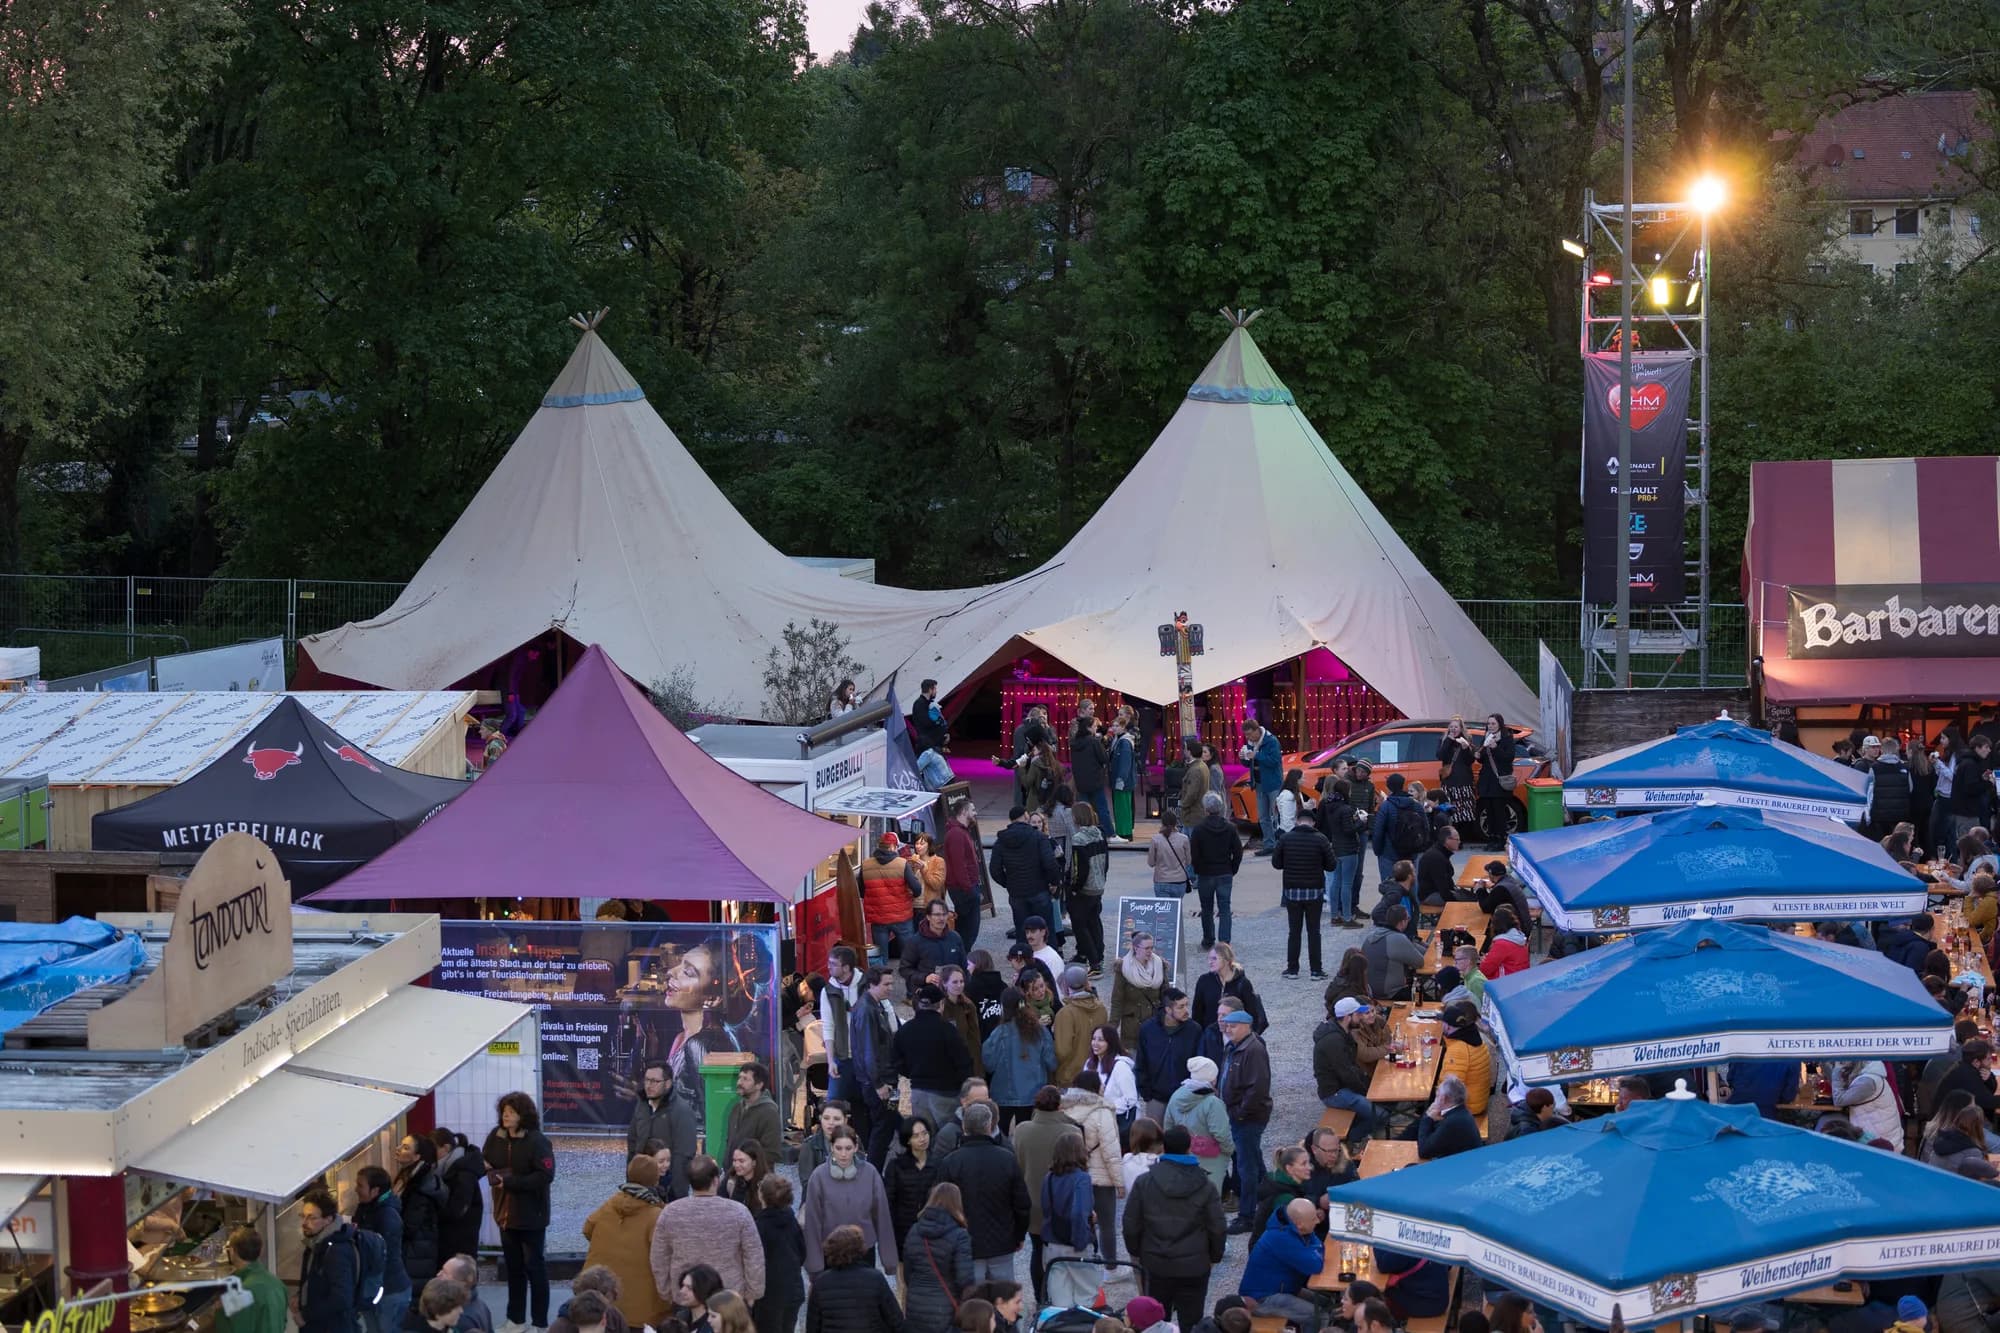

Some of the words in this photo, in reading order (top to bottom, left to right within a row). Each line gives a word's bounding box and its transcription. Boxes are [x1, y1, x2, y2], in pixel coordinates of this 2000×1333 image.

[1610, 486, 1659, 494] RAULT
[1637, 494, 1658, 502] PRO+
[1628, 572, 1654, 583] HM
[815, 751, 863, 790] BURGERBULLI
[1737, 795, 1770, 808] ÄLTESTE
[1771, 800, 1810, 812] BRAUEREI
[1811, 804, 1827, 813] DER
[1828, 806, 1851, 816] WELT
[275, 826, 325, 851] HACK
[1130, 901, 1154, 916] Burger
[1771, 900, 1811, 912] ÄLTESTE
[1812, 900, 1857, 911] BRAUEREI
[1858, 900, 1878, 911] DER
[1878, 899, 1907, 911] WELT
[441, 947, 474, 956] Aktuelle
[456, 958, 469, 967] die
[470, 959, 498, 968] älteste
[499, 959, 521, 968] Stadt
[521, 961, 532, 969] an
[534, 960, 548, 969] der
[549, 960, 564, 969] Isar
[577, 962, 611, 971] erleben,
[441, 970, 465, 980] gibt's
[466, 970, 474, 978] in
[476, 970, 490, 978] der
[491, 970, 567, 981] Touristinformation:
[566, 1023, 575, 1031] in
[575, 1022, 608, 1034] Freising
[541, 1033, 601, 1043] eranstaltungen
[1633, 1038, 1721, 1063] Weihenstephan
[1767, 1036, 1816, 1049] ÄLTESTE
[1817, 1036, 1874, 1048] BRAUEREI
[1876, 1036, 1900, 1048] DER
[1901, 1035, 1934, 1047] WELT
[542, 1052, 569, 1061] online:
[1397, 1220, 1452, 1250] Weihenstephan
[1482, 1248, 1518, 1273] ÄLTESTE
[1517, 1266, 1558, 1291] BRAUEREI
[1557, 1278, 1576, 1296] DER
[1576, 1286, 1598, 1308] WELT
[1740, 1254, 1833, 1289] Weihenstephan
[1878, 1242, 1928, 1261] ÄLTESTE
[1928, 1239, 1985, 1256] BRAUEREI
